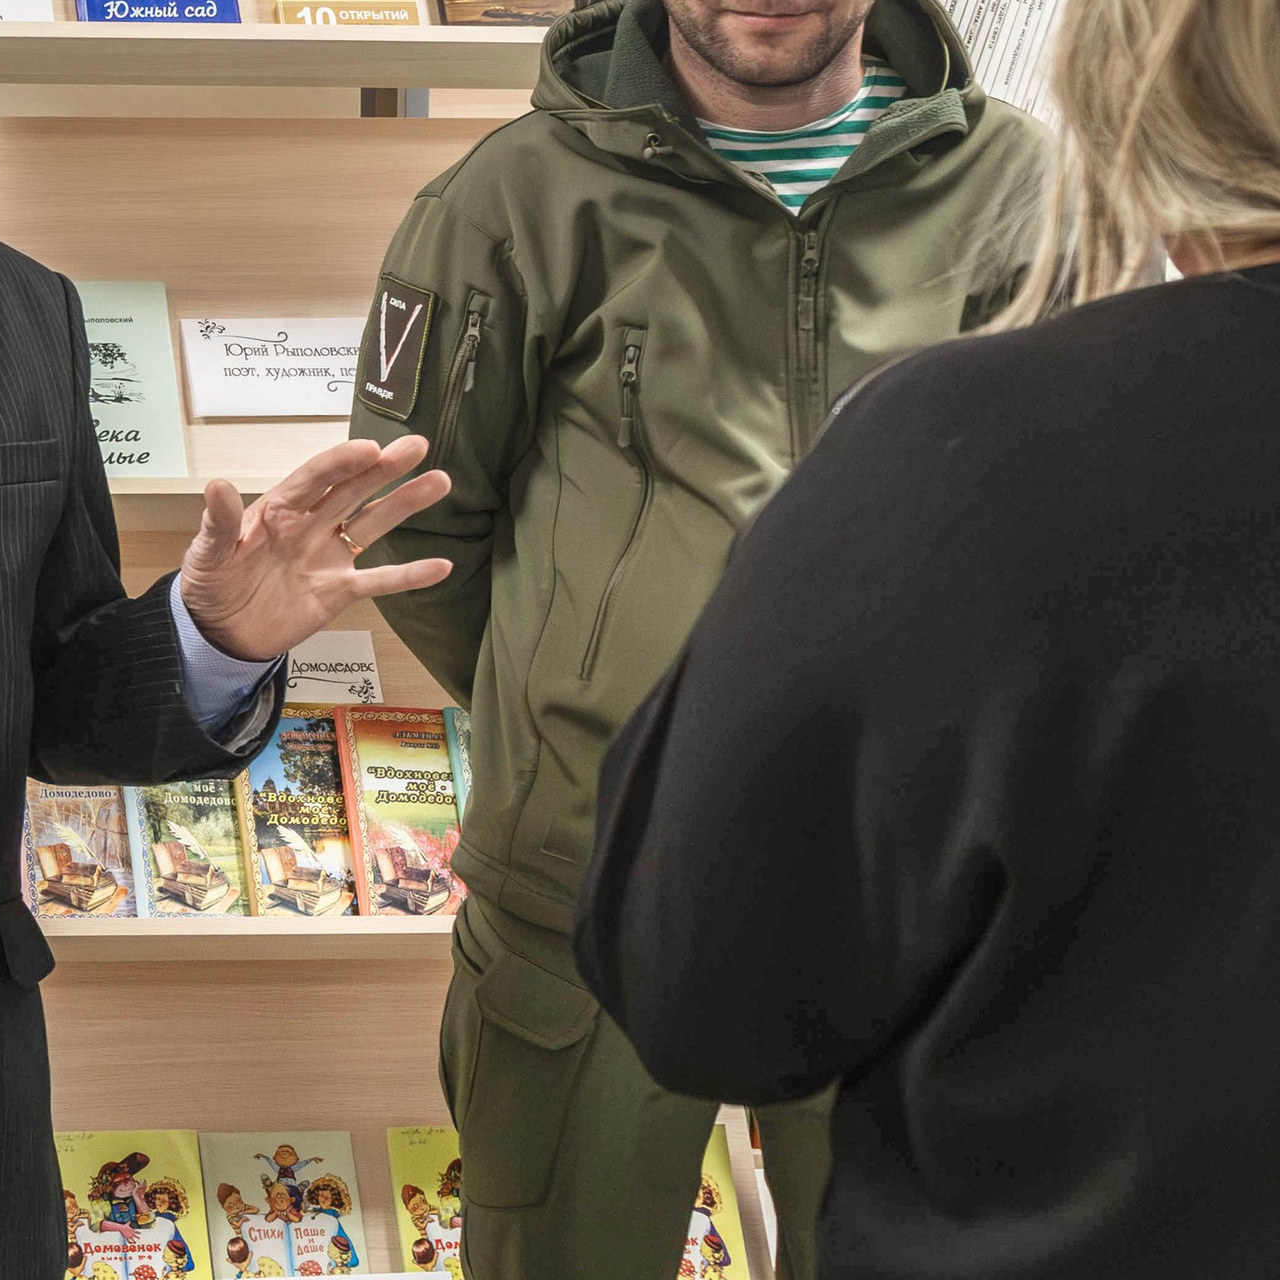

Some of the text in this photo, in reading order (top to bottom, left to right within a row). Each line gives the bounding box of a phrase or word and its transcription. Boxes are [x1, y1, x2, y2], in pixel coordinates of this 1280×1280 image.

[104, 0, 218, 19] Южный сад
[339, 9, 409, 20] ОТКРЫТИЙ
[224, 343, 360, 360] Юрий Рыполовски
[224, 367, 260, 378] поэт,
[265, 367, 335, 381] художник,
[365, 382, 394, 400] ПРАВДЕ
[93, 419, 141, 443] ека
[104, 451, 150, 465] лые
[406, 780, 435, 792] моё
[266, 814, 347, 826] Домодедо
[248, 1227, 284, 1243] Стихи
[294, 1227, 326, 1240] Паше
[296, 1245, 324, 1256] Даше
